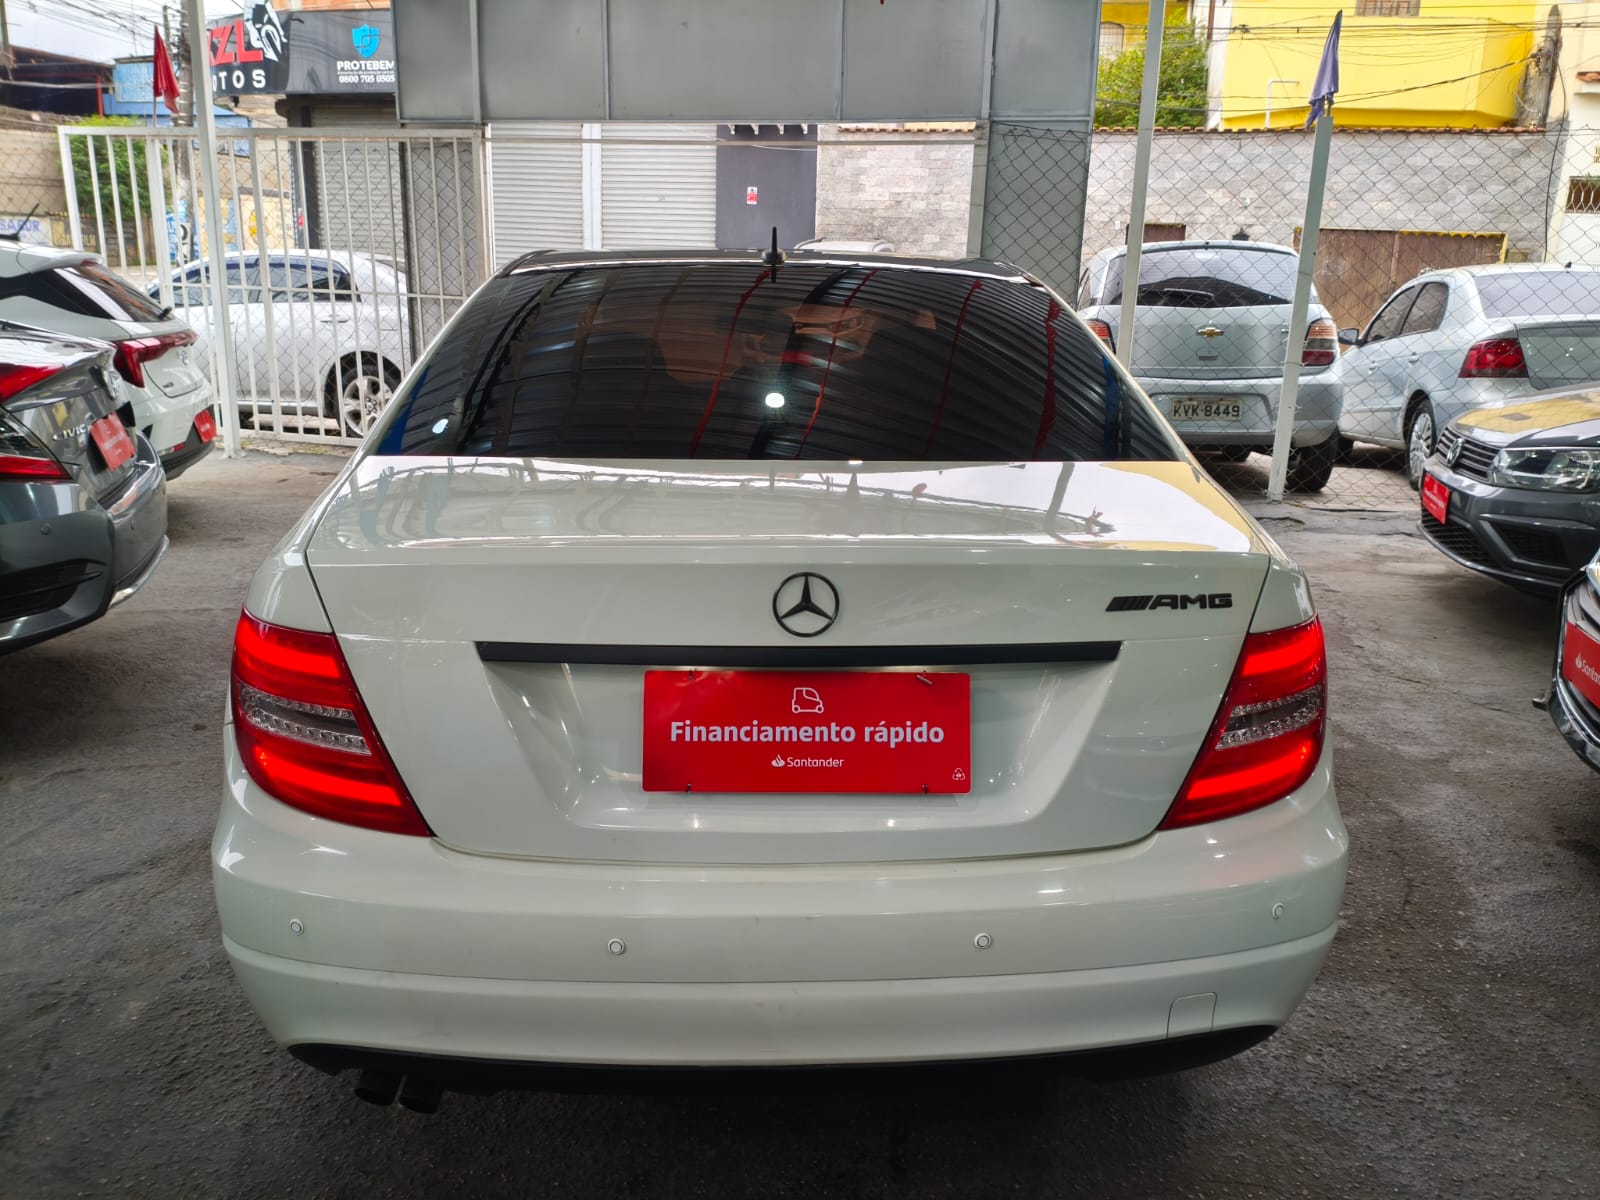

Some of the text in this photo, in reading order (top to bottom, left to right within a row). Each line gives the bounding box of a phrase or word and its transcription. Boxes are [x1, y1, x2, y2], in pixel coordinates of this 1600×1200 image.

[207, 19, 263, 66] ZL
[336, 60, 395, 71] PROTEBEM
[339, 75, 396, 84] 0800 705 0505
[1148, 593, 1233, 610] AMG
[670, 719, 945, 749] Financiamento rápido
[786, 754, 845, 768] Santander
